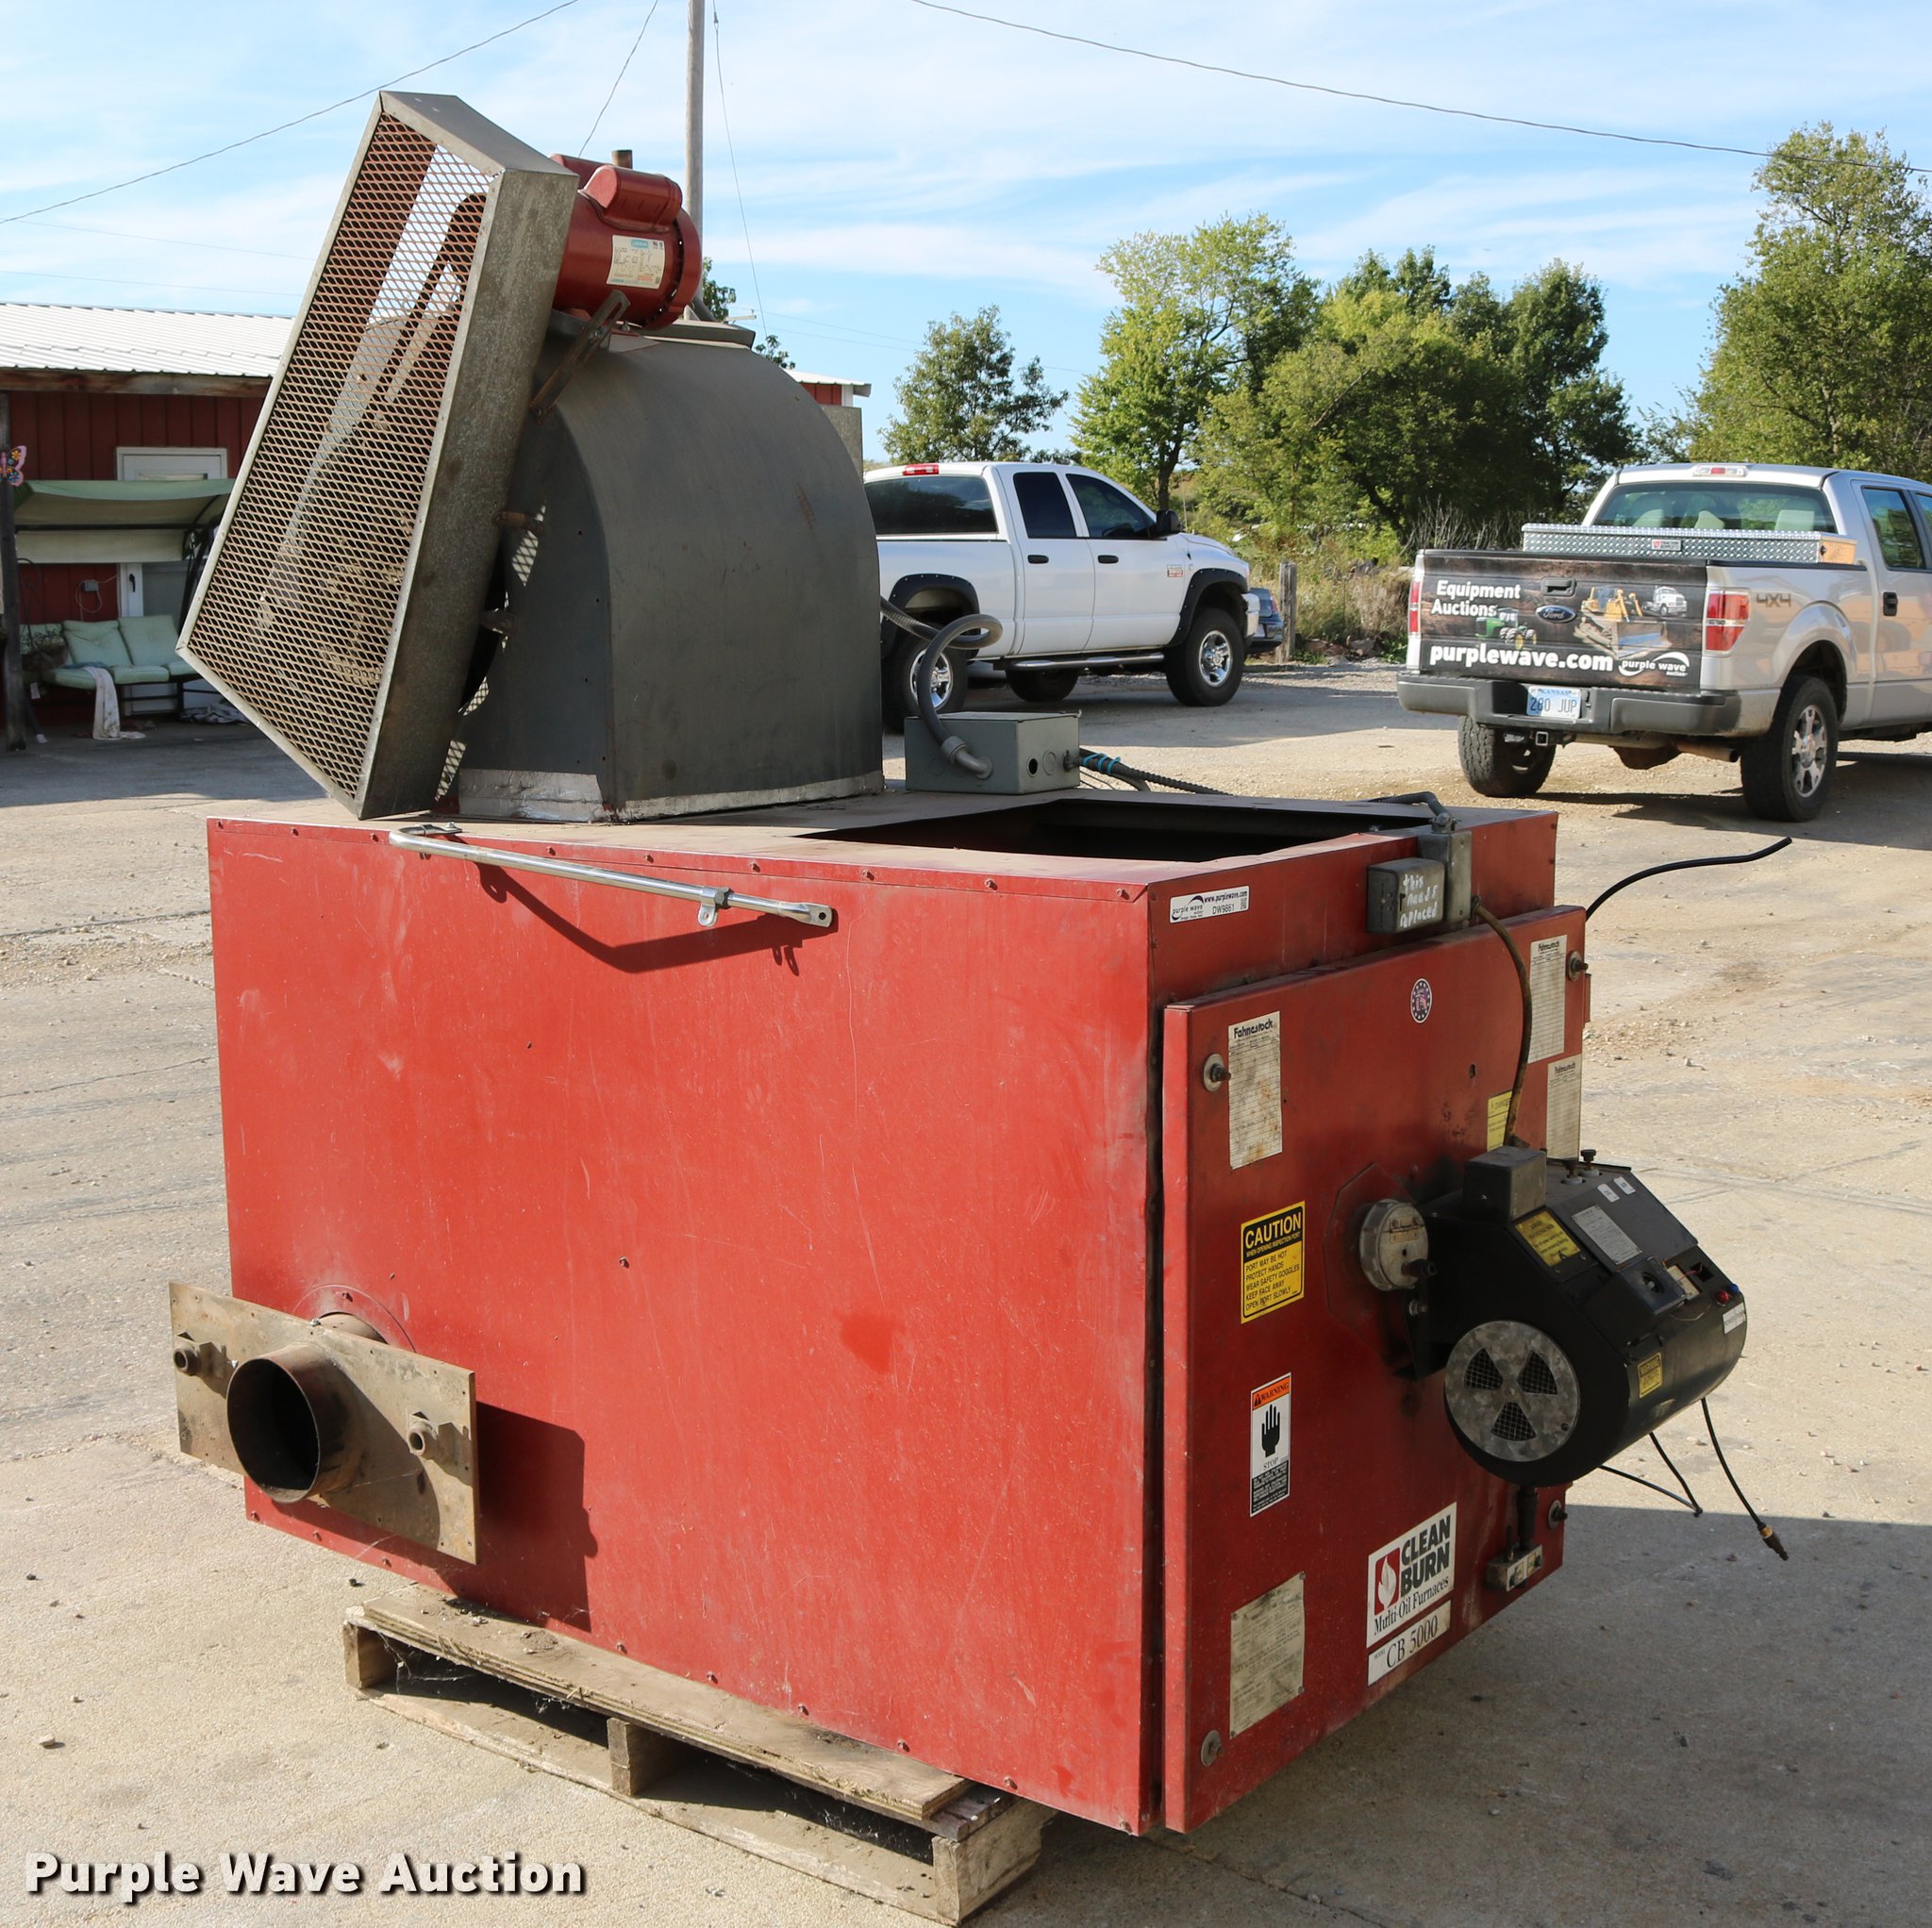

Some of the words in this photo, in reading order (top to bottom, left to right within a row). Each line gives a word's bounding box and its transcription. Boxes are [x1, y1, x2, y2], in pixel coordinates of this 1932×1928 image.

[1437, 579, 1521, 601] Equipment
[1431, 598, 1498, 617] Auctions
[1542, 608, 1565, 619] Ford
[1430, 643, 1614, 672] purplewave.com
[1622, 659, 1656, 671] purple
[1657, 663, 1687, 672] wave
[1557, 699, 1577, 713] JUP
[1204, 891, 1247, 903] www.purplewave.com
[1173, 905, 1189, 914] purple
[1234, 1019, 1273, 1039] Fahnestock
[1245, 1212, 1301, 1249] CAUTION
[1246, 1262, 1257, 1271] PORT
[1259, 1257, 1269, 1266] MAY
[1278, 1250, 1287, 1258] HOT
[1246, 1268, 1266, 1281] PROTECT
[1268, 1260, 1283, 1271] HANDS
[1246, 1280, 1259, 1290] WEAR
[1260, 1272, 1276, 1284] SAFETY
[1278, 1263, 1299, 1276] GOGGLES
[1246, 1290, 1257, 1300] KEEP
[1259, 1285, 1271, 1293] FACE
[1273, 1280, 1283, 1288] AWAY
[1246, 1300, 1257, 1310] OPEN
[1260, 1293, 1272, 1304] PORT
[1274, 1286, 1290, 1297] SLOWLY
[1260, 1381, 1290, 1401] WARNING
[1263, 1456, 1279, 1471] STOP
[1401, 1514, 1451, 1566] CLEAN
[1400, 1541, 1450, 1598] BURN
[1374, 1596, 1411, 1637] Multi-Oil
[1412, 1575, 1449, 1610] Furnaces
[1386, 1637, 1406, 1669] CB
[1409, 1614, 1439, 1654] 5000
